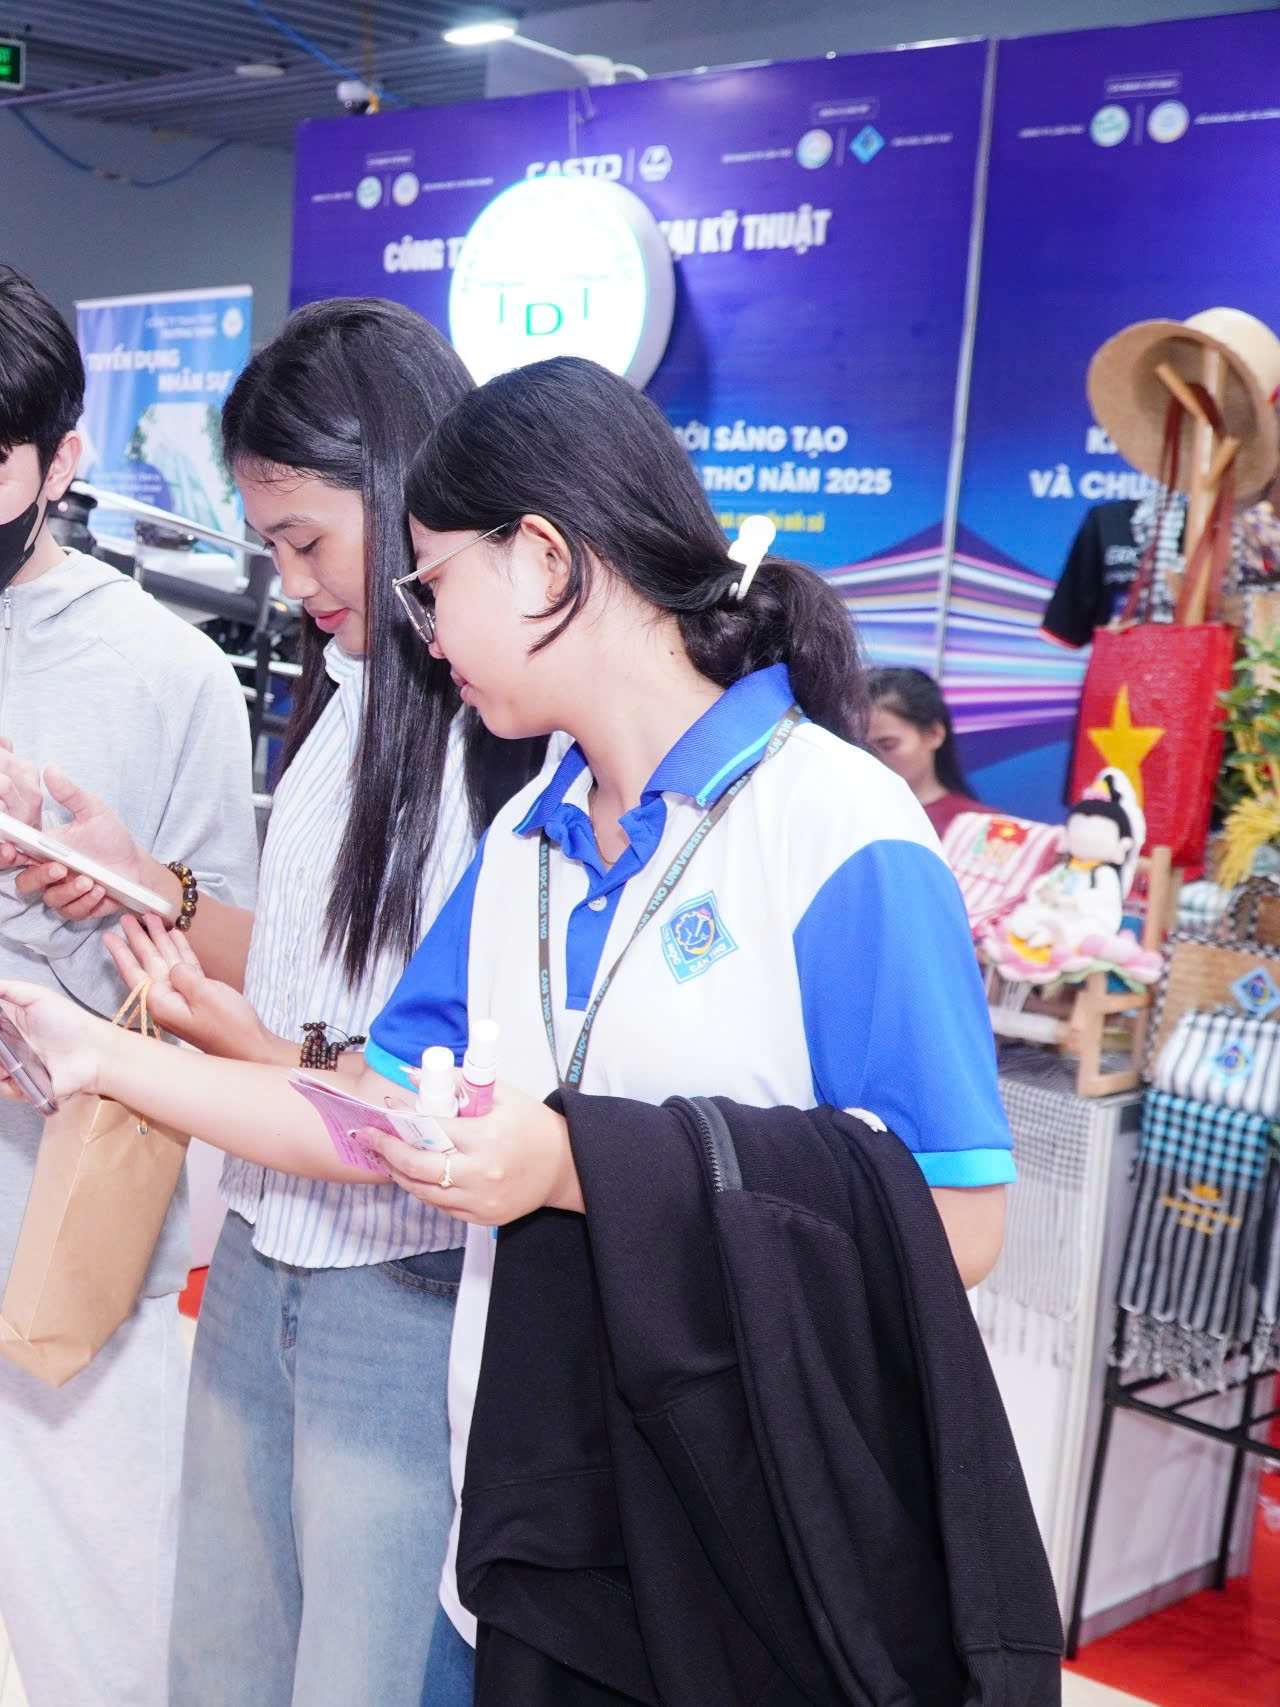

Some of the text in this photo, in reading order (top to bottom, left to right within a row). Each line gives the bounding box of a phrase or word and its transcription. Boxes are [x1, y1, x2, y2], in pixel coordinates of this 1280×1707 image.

[742, 203, 832, 256] THUẬT
[714, 419, 788, 453] SÁNG
[791, 425, 849, 459] TẠO
[758, 461, 821, 495] NĂM
[824, 467, 893, 495] 2025
[663, 817, 713, 888] UNIVERSITY
